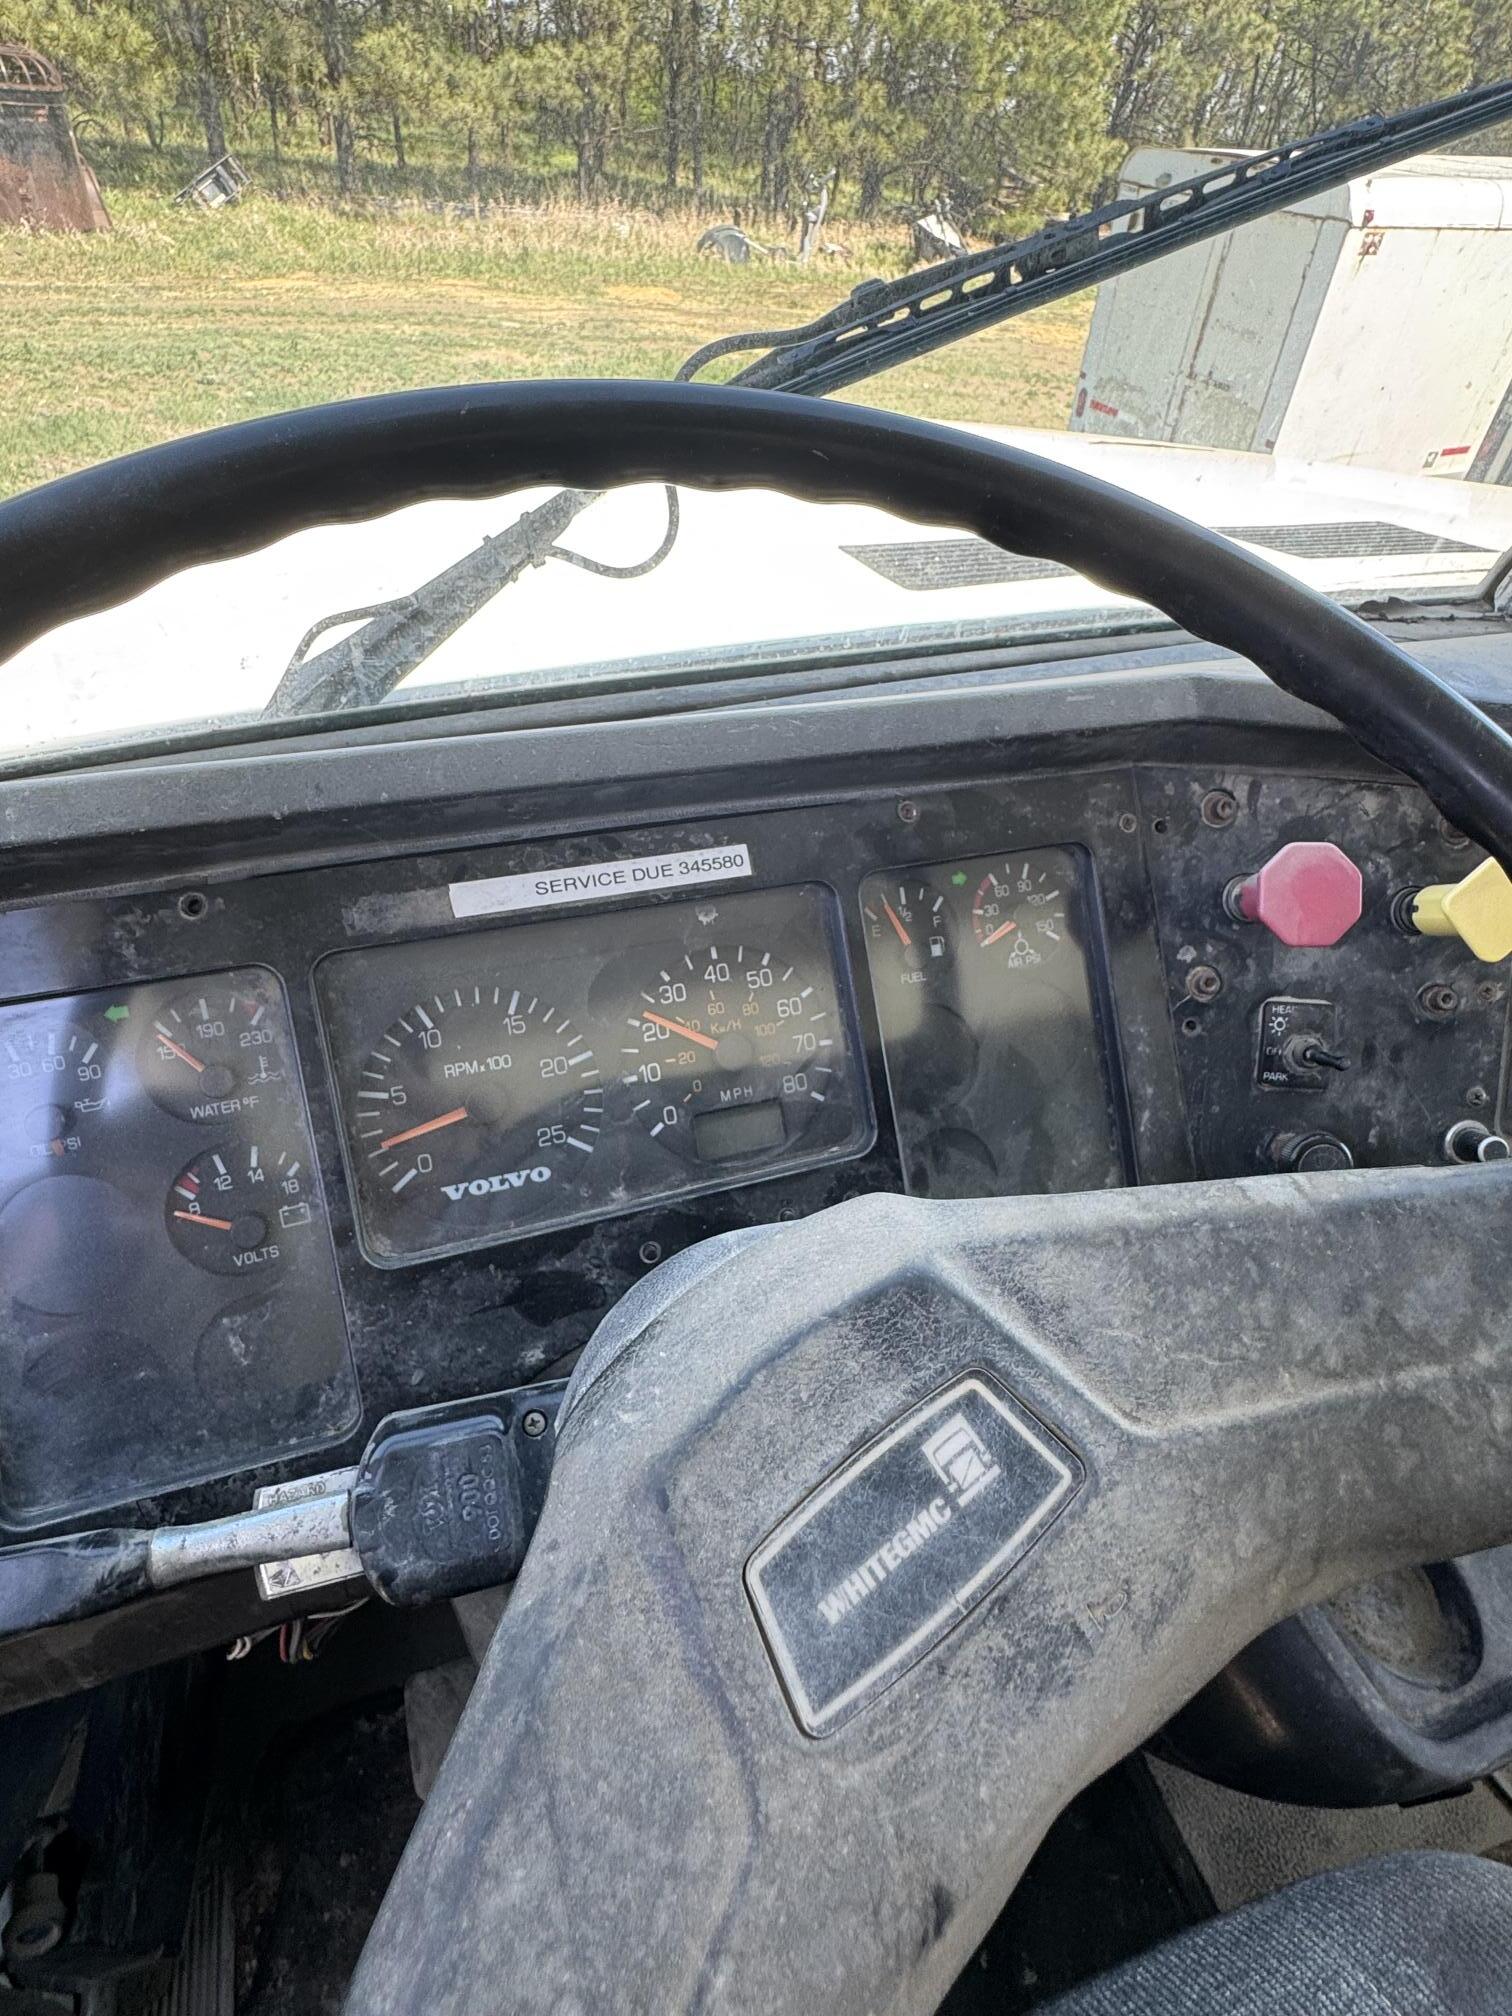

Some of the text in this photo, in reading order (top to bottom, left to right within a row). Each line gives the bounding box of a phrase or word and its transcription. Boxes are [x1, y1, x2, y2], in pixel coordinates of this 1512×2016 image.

[535, 853, 744, 896] SERVICE DUE 345580
[994, 884, 1009, 898] 60
[1017, 880, 1032, 893] 90
[984, 904, 999, 917] 30
[872, 925, 881, 937] E
[933, 916, 943, 928] F
[985, 924, 994, 935] 0
[704, 963, 730, 984] 40
[746, 968, 773, 989] 50
[901, 971, 927, 984] FUEL
[659, 983, 687, 1005] 30
[707, 1002, 725, 1016] 60
[742, 1002, 759, 1016] 80
[776, 997, 802, 1018] 60
[196, 1021, 225, 1039] 190
[502, 1015, 526, 1036] 15
[642, 1023, 670, 1043] 20
[754, 1022, 776, 1036] 100
[239, 1030, 273, 1047] 230
[418, 1029, 442, 1049] 10
[792, 1032, 816, 1053] 70
[42, 1056, 65, 1072] 60
[678, 1051, 696, 1064] 20
[8, 1062, 32, 1079] 30
[78, 1065, 101, 1081] 90
[539, 1056, 568, 1078] 20
[638, 1063, 661, 1082] 10
[782, 1072, 808, 1094] 80
[1263, 1072, 1289, 1081] PARK
[693, 1080, 702, 1092] 0
[720, 1084, 753, 1102] MPH
[390, 1086, 407, 1105] 5
[190, 1098, 241, 1119] WATER
[663, 1105, 677, 1124] 0
[537, 1125, 567, 1147] 25
[417, 1153, 433, 1173] 0
[213, 1175, 233, 1191] 12
[248, 1168, 265, 1184] 14
[440, 1166, 551, 1201] VOLVO
[281, 1180, 300, 1195] 18
[188, 1202, 201, 1215] 8
[233, 1246, 280, 1266] VOLTS
[817, 1498, 953, 1626] WHITEGMC
